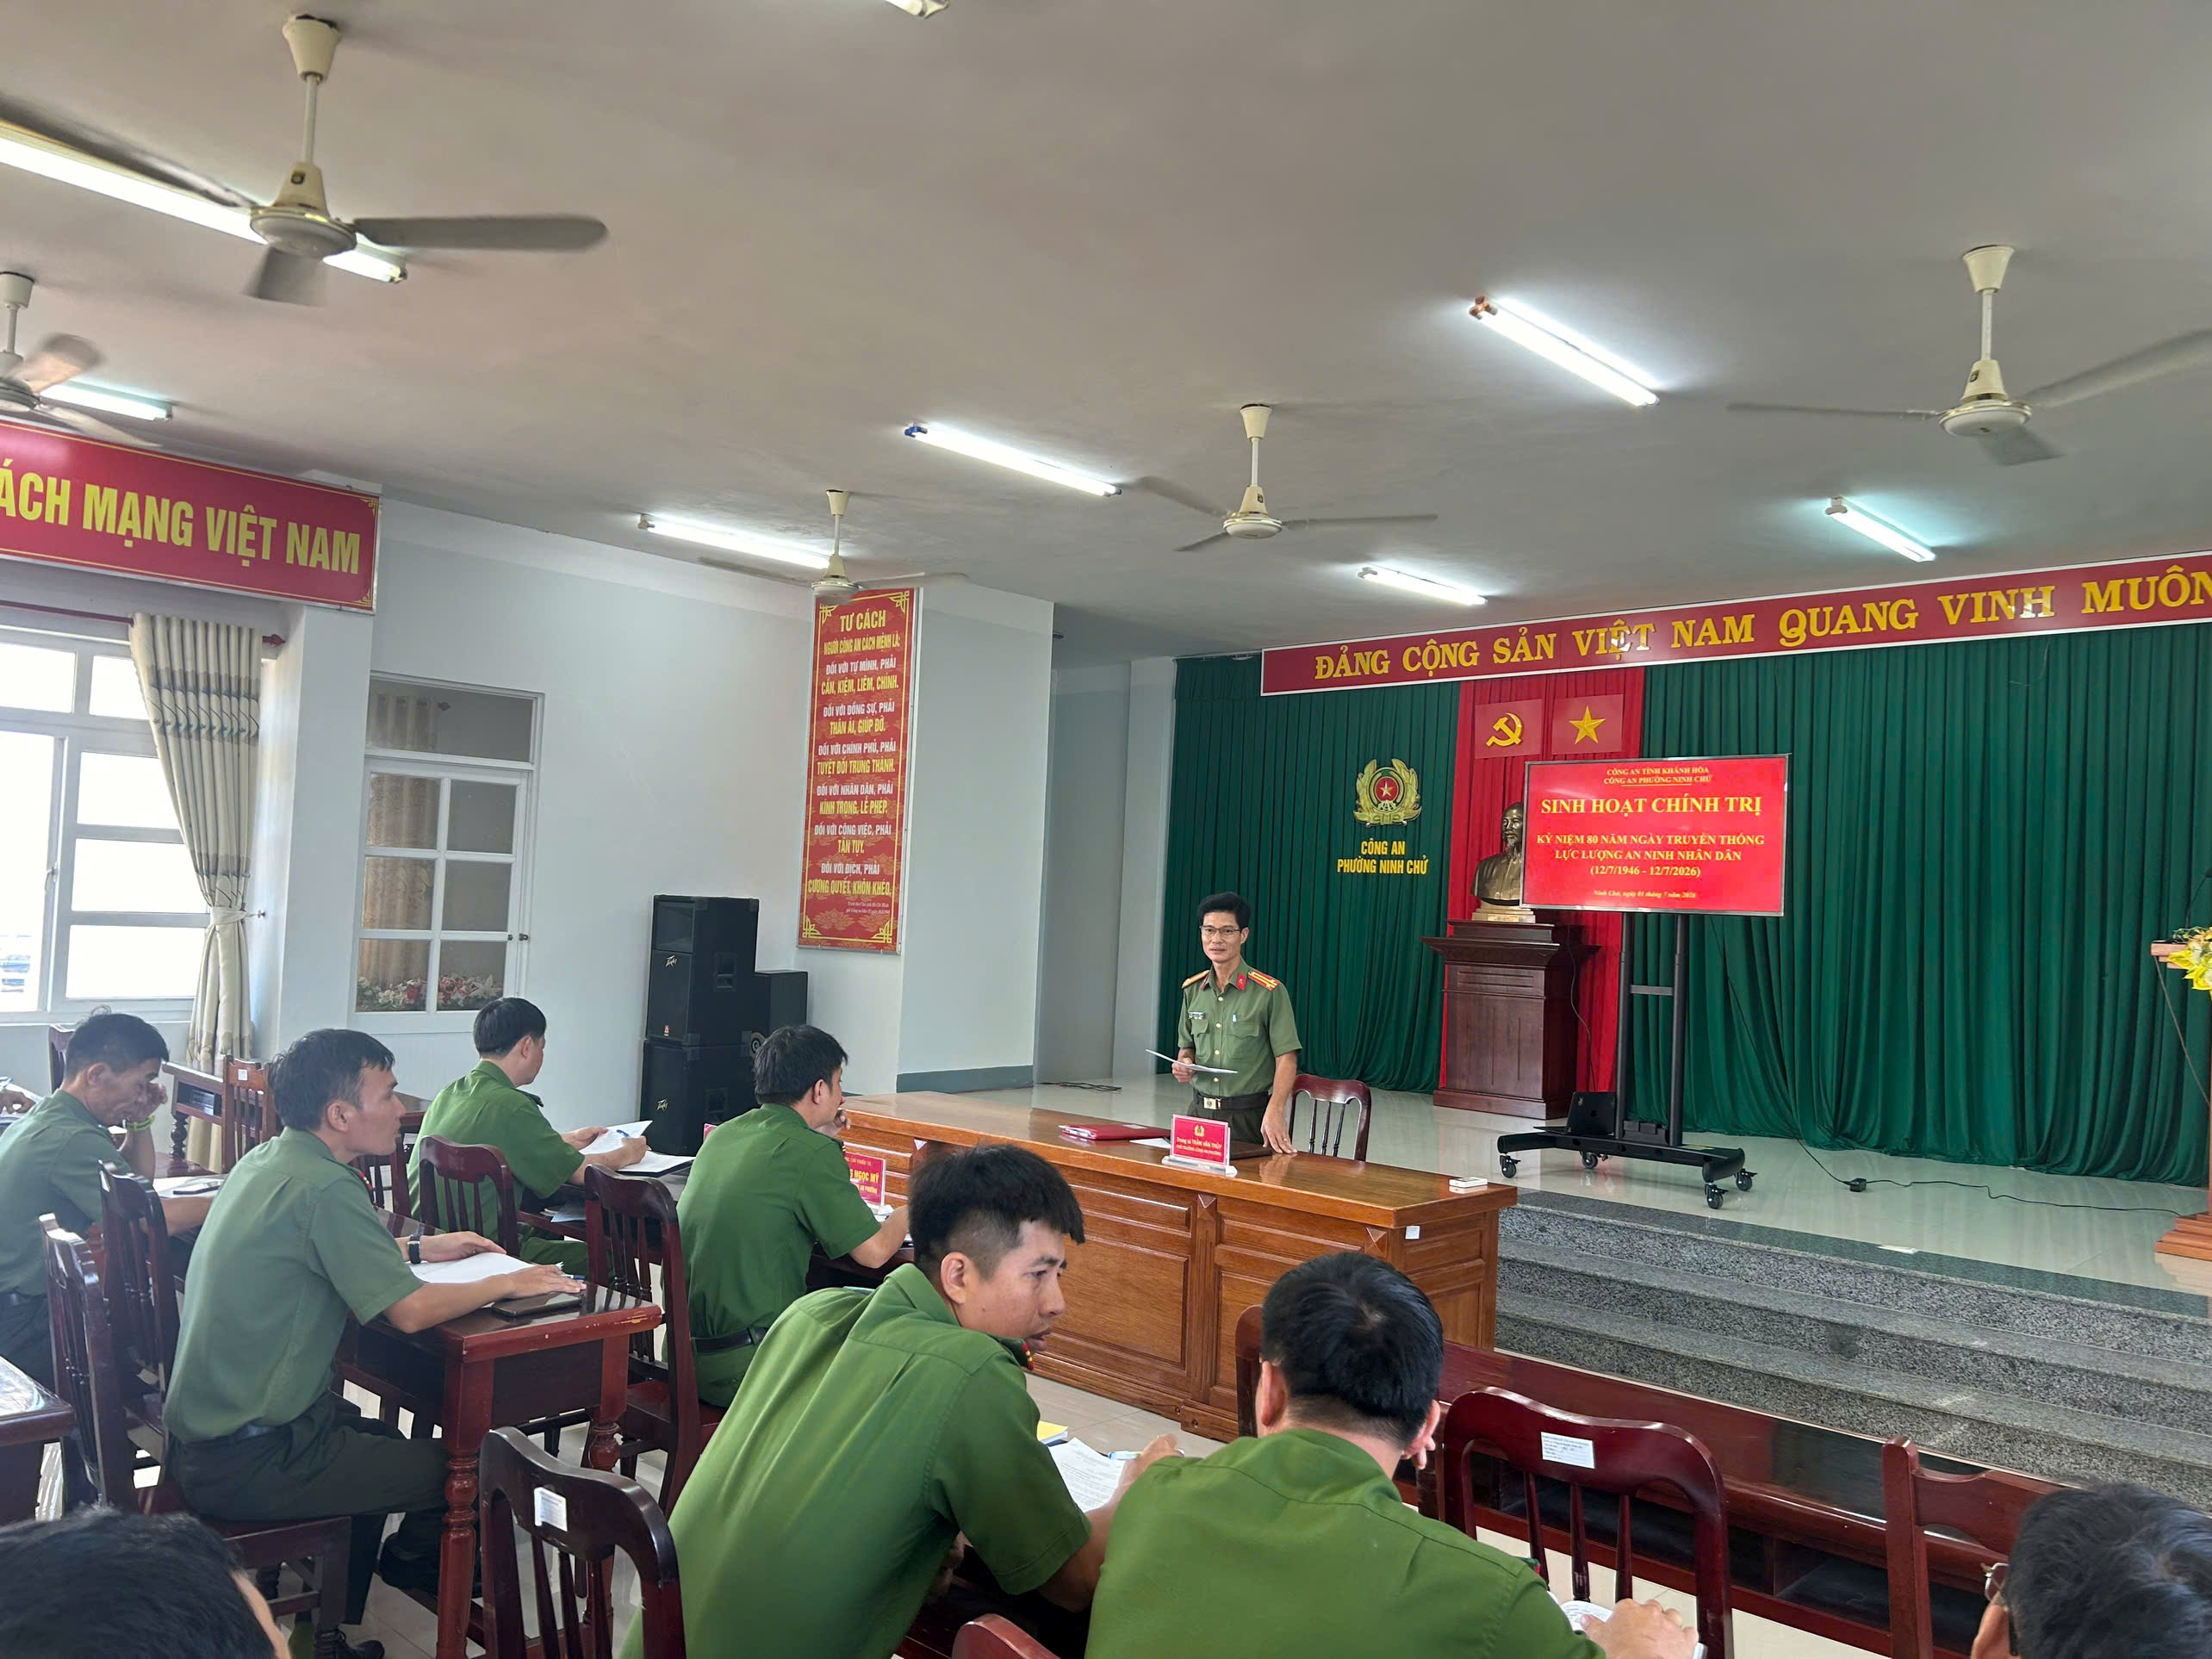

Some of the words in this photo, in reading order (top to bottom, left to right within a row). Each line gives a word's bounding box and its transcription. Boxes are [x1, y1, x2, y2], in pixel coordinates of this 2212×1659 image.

[82, 482, 193, 548] MẠNG
[206, 504, 276, 567] VIỆT
[285, 521, 360, 575] NAM
[841, 611, 854, 632] TƯ
[856, 608, 886, 631] CÁCH
[1314, 644, 1390, 680] ĐẢNG
[1402, 638, 1480, 678] CỘNG
[1492, 626, 1556, 665] SẢN
[1572, 619, 1656, 661] VIỆT
[1671, 612, 1755, 648] NAM
[1779, 599, 1918, 647] QUANG
[1938, 586, 2055, 624] VINH
[2081, 564, 2212, 614] MUÔN
[840, 637, 854, 654] CÔNG
[854, 637, 862, 652] AN
[862, 634, 876, 651] CÁCH
[826, 661, 837, 675] ĐỐI
[838, 661, 848, 674] VỚI
[850, 660, 859, 674] TỰ
[880, 654, 896, 669] PHẢI
[823, 703, 834, 718] ĐỐI
[836, 703, 846, 716] VỚI
[848, 702, 865, 716] ĐỒNG
[879, 699, 895, 714] PHẢI
[830, 720, 847, 735] THÂN
[858, 718, 873, 733] GIÚP
[819, 742, 830, 756] ĐỐI
[830, 742, 842, 755] VỚI
[842, 741, 862, 755] CHÍNH
[880, 736, 896, 753] PHẢI
[817, 760, 836, 777] TUYỆT
[837, 757, 848, 774] ĐỐI
[849, 760, 870, 774] TRUNG
[1662, 766, 1690, 774] KHÁNH
[817, 784, 828, 797] ĐỐI
[829, 784, 840, 796] VỚI
[841, 784, 859, 796] NHÂN
[877, 781, 893, 795] PHẢI
[820, 798, 835, 815] KÍNH
[861, 796, 868, 814] LỄ
[1541, 799, 1585, 814] SINH
[1592, 798, 1646, 817] HOẠT
[1651, 793, 1722, 814] CHÍNH
[1724, 797, 1762, 817] TRỊ
[815, 822, 825, 836] ĐỐI
[827, 823, 837, 836] VỚI
[838, 823, 856, 836] CÔNG
[876, 821, 892, 836] PHẢI
[838, 837, 850, 856] TẬN
[1361, 837, 1389, 855] CÔNG
[1391, 841, 1406, 855] AN
[1557, 833, 1584, 846] NIỆM
[1587, 836, 1599, 844] 80
[1602, 832, 1627, 845] NĂM
[1631, 833, 1663, 845] NGÀY
[1667, 831, 1716, 845] TRUYỀN
[1719, 831, 1765, 846] THỐNG
[1338, 855, 1376, 873] PHƯỜNG
[1380, 860, 1404, 874] NINH
[1407, 854, 1429, 875] CHỬ
[1556, 849, 1578, 862] LỰC
[1581, 849, 1622, 862] LƯỢNG
[1625, 851, 1641, 861] AN
[1644, 851, 1675, 861] NINH
[1678, 849, 1712, 861] NHÂN
[822, 861, 831, 874] ĐỐI
[834, 861, 844, 874] VỚI
[864, 861, 879, 875] PHẢI
[1590, 866, 1640, 876] (12/7/1946
[1650, 866, 1701, 878] 12/7/2026)
[854, 1170, 869, 1182] NGỌC
